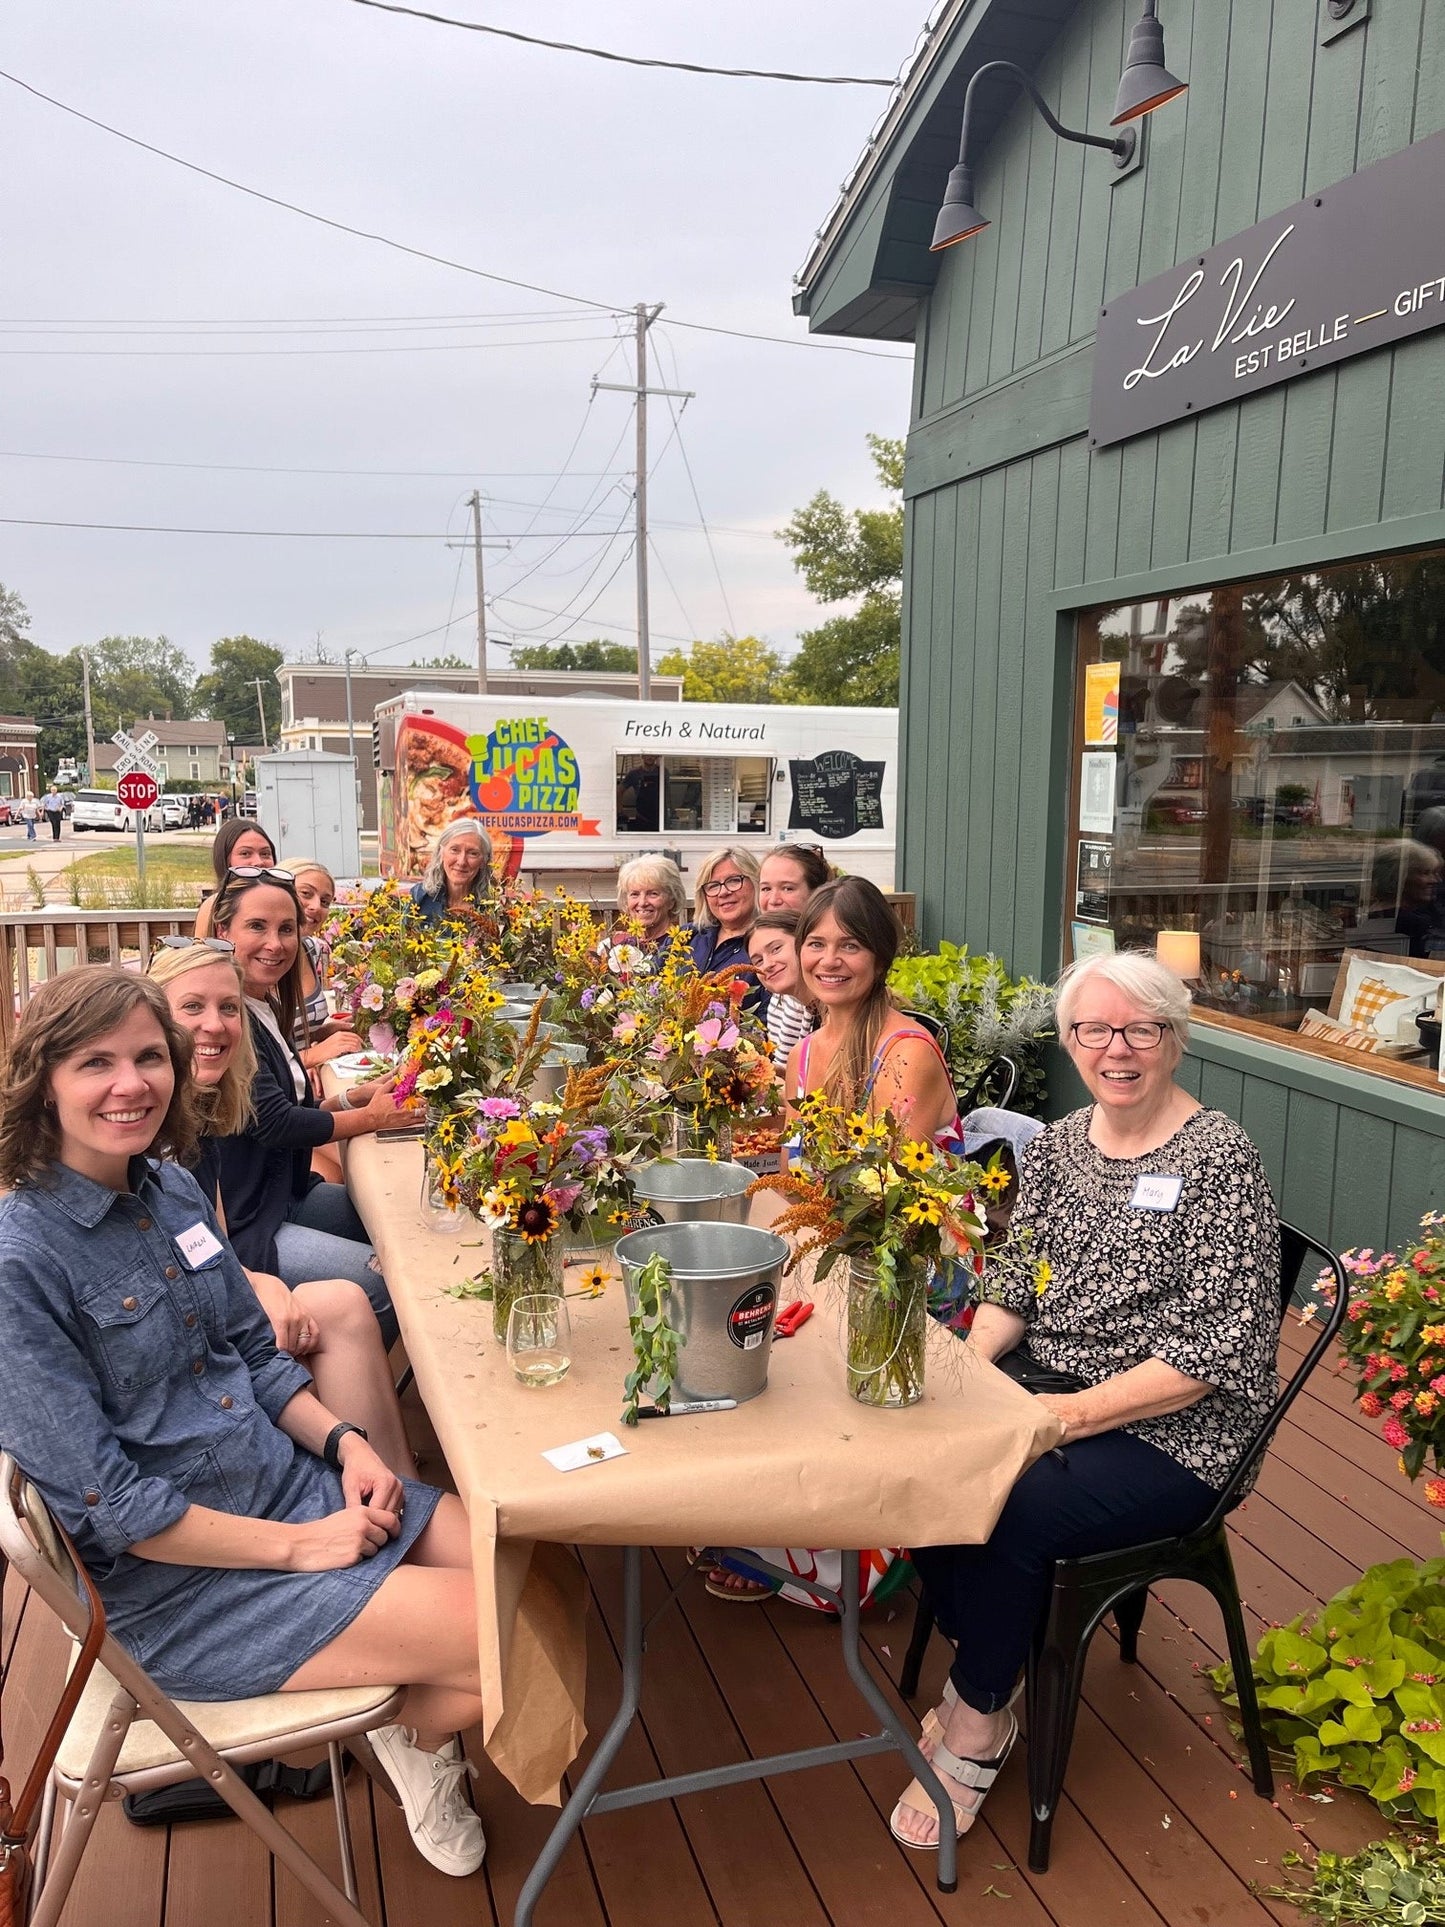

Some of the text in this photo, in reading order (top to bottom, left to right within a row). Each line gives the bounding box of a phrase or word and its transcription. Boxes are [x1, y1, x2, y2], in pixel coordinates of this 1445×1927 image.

[1122, 224, 1296, 390] La Vie
[1234, 276, 1445, 379] EST BELLE GIFT
[495, 716, 549, 745] CHEF
[625, 720, 766, 740] Fresh & Natural
[474, 746, 576, 785] LUCAS
[814, 752, 858, 773] WELCOME
[119, 783, 156, 799] STOP
[518, 784, 578, 812] PIZZA
[743, 1159, 760, 1168] Made
[1143, 1186, 1164, 1204] Mary
[738, 1302, 772, 1320] BEHRENS
